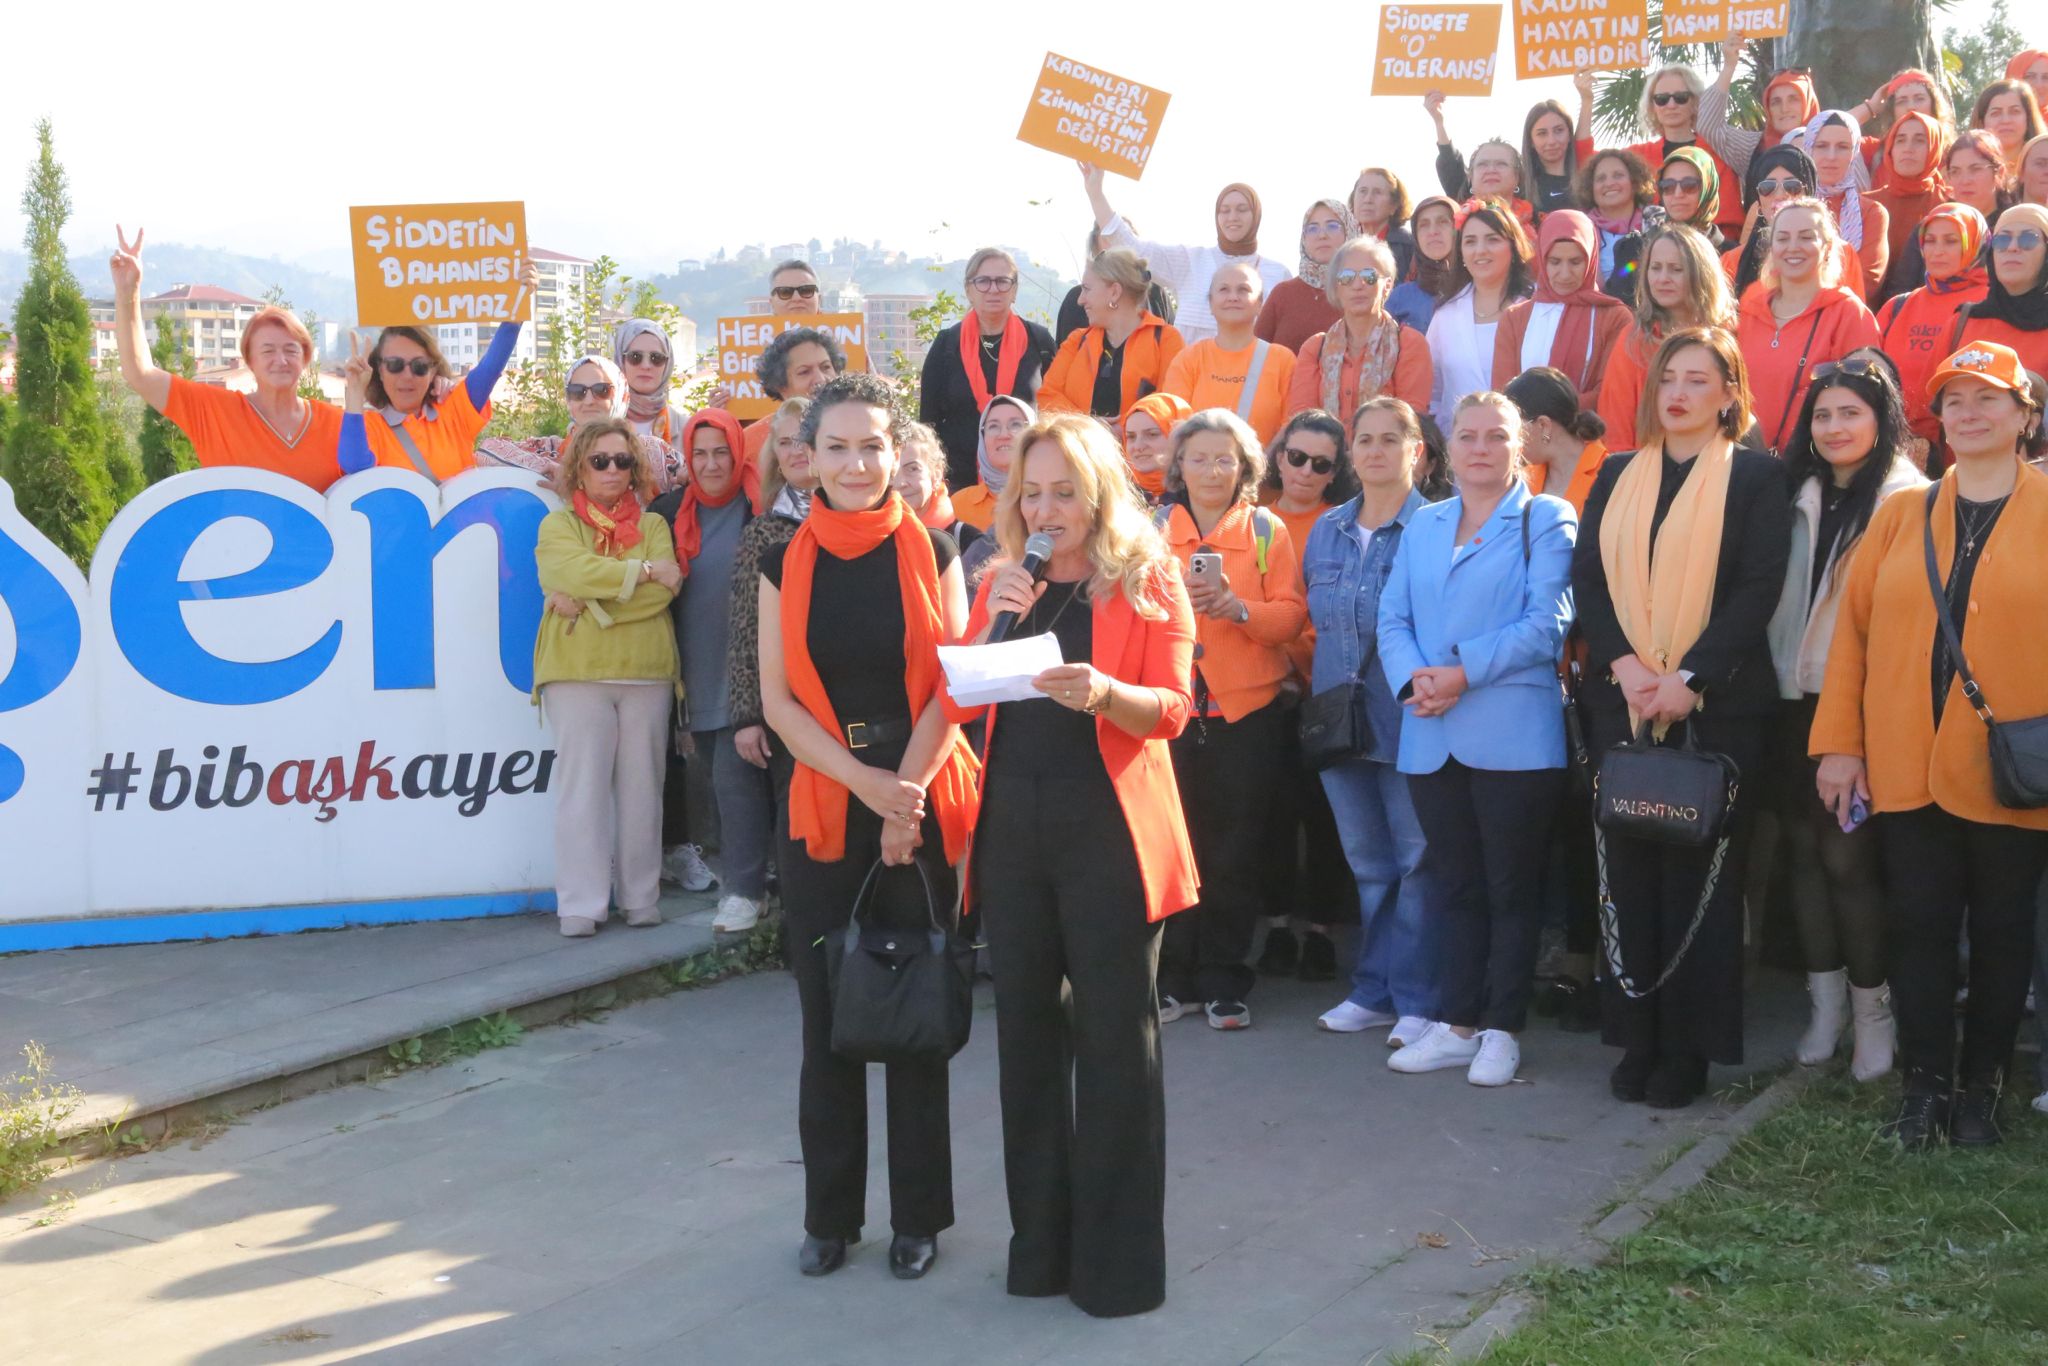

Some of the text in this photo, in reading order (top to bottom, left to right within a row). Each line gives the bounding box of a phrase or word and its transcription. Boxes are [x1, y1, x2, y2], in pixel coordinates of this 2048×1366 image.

[1385, 6, 1469, 33] ŞİDDETE
[1523, 15, 1639, 44] HAYATIN
[1664, 3, 1786, 37] YAŞAM İSTER!
[1382, 52, 1496, 85] TOLERANS!
[1527, 38, 1648, 72] KALBİDİR!
[1046, 55, 1149, 107] KADINLARI
[1038, 87, 1147, 143] ZİHNİYETİNİ
[1093, 92, 1148, 125] DEĞİL
[1056, 117, 1150, 168] DEĞİŞTİR!
[366, 215, 514, 253] ŞİDDETİN
[379, 250, 521, 287] BAHANESİ
[412, 284, 527, 320] OLMAZ!
[720, 320, 775, 347] HER
[1612, 798, 1698, 821] VALENTINO
